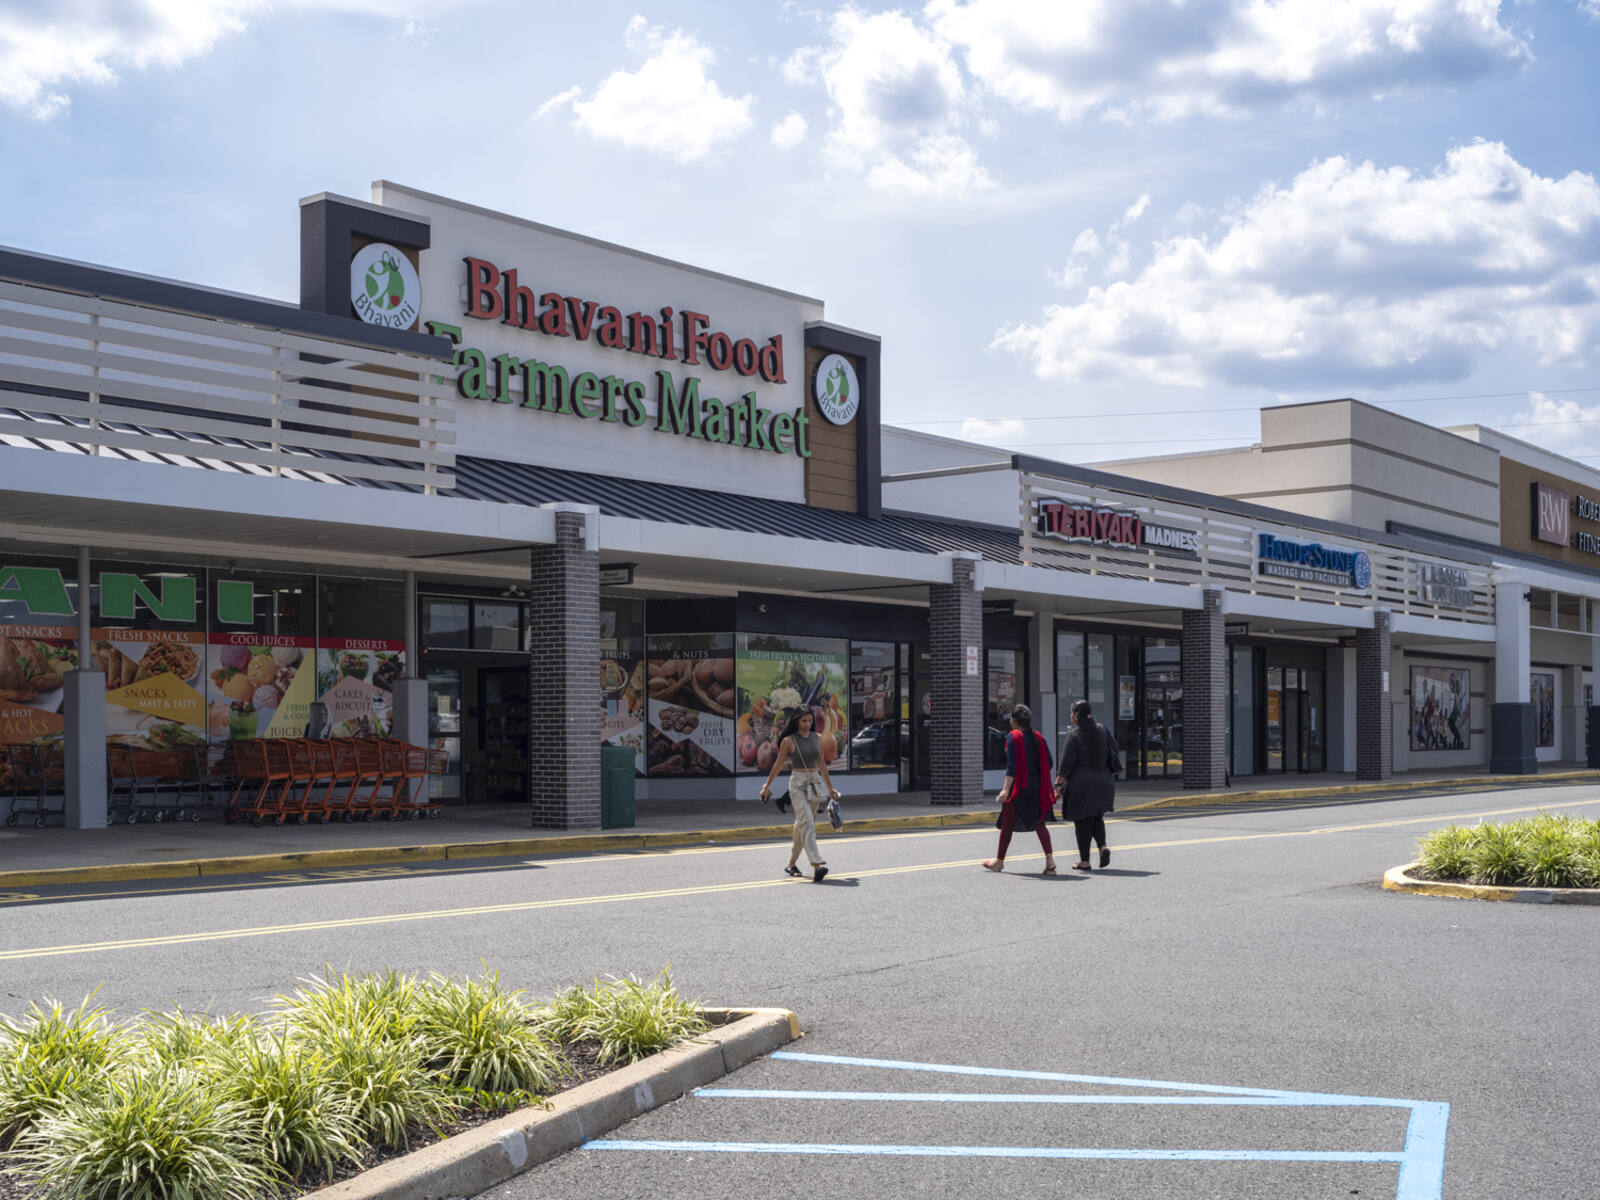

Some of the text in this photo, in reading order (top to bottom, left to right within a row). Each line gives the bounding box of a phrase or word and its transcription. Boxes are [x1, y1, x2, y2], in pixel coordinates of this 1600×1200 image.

[354, 293, 416, 328] Bhavani
[463, 256, 787, 384] Bhavani Food
[819, 392, 856, 419] Bhavani
[655, 370, 812, 457] Market
[1539, 491, 1568, 545] RWJ
[1046, 504, 1200, 551] TERIYAKI MADNESS
[1311, 544, 1353, 572] STONE
[1267, 564, 1349, 585] MASSAGE AND FACIAL SPA
[15, 625, 63, 639] SNACKS
[108, 630, 189, 642] FRESH SNACKS
[230, 634, 296, 647] COOL JUICES
[345, 639, 388, 650] DESSERTS
[672, 649, 710, 659] & NUTS
[124, 687, 167, 698] SNACKS
[335, 688, 364, 699] CAKES
[173, 699, 197, 709] TASTY
[1, 708, 32, 719] & HOT
[0, 719, 49, 735] ACKS
[271, 727, 303, 737] JUICES
[704, 728, 725, 737] DRY
[699, 736, 732, 745] FRUITS
